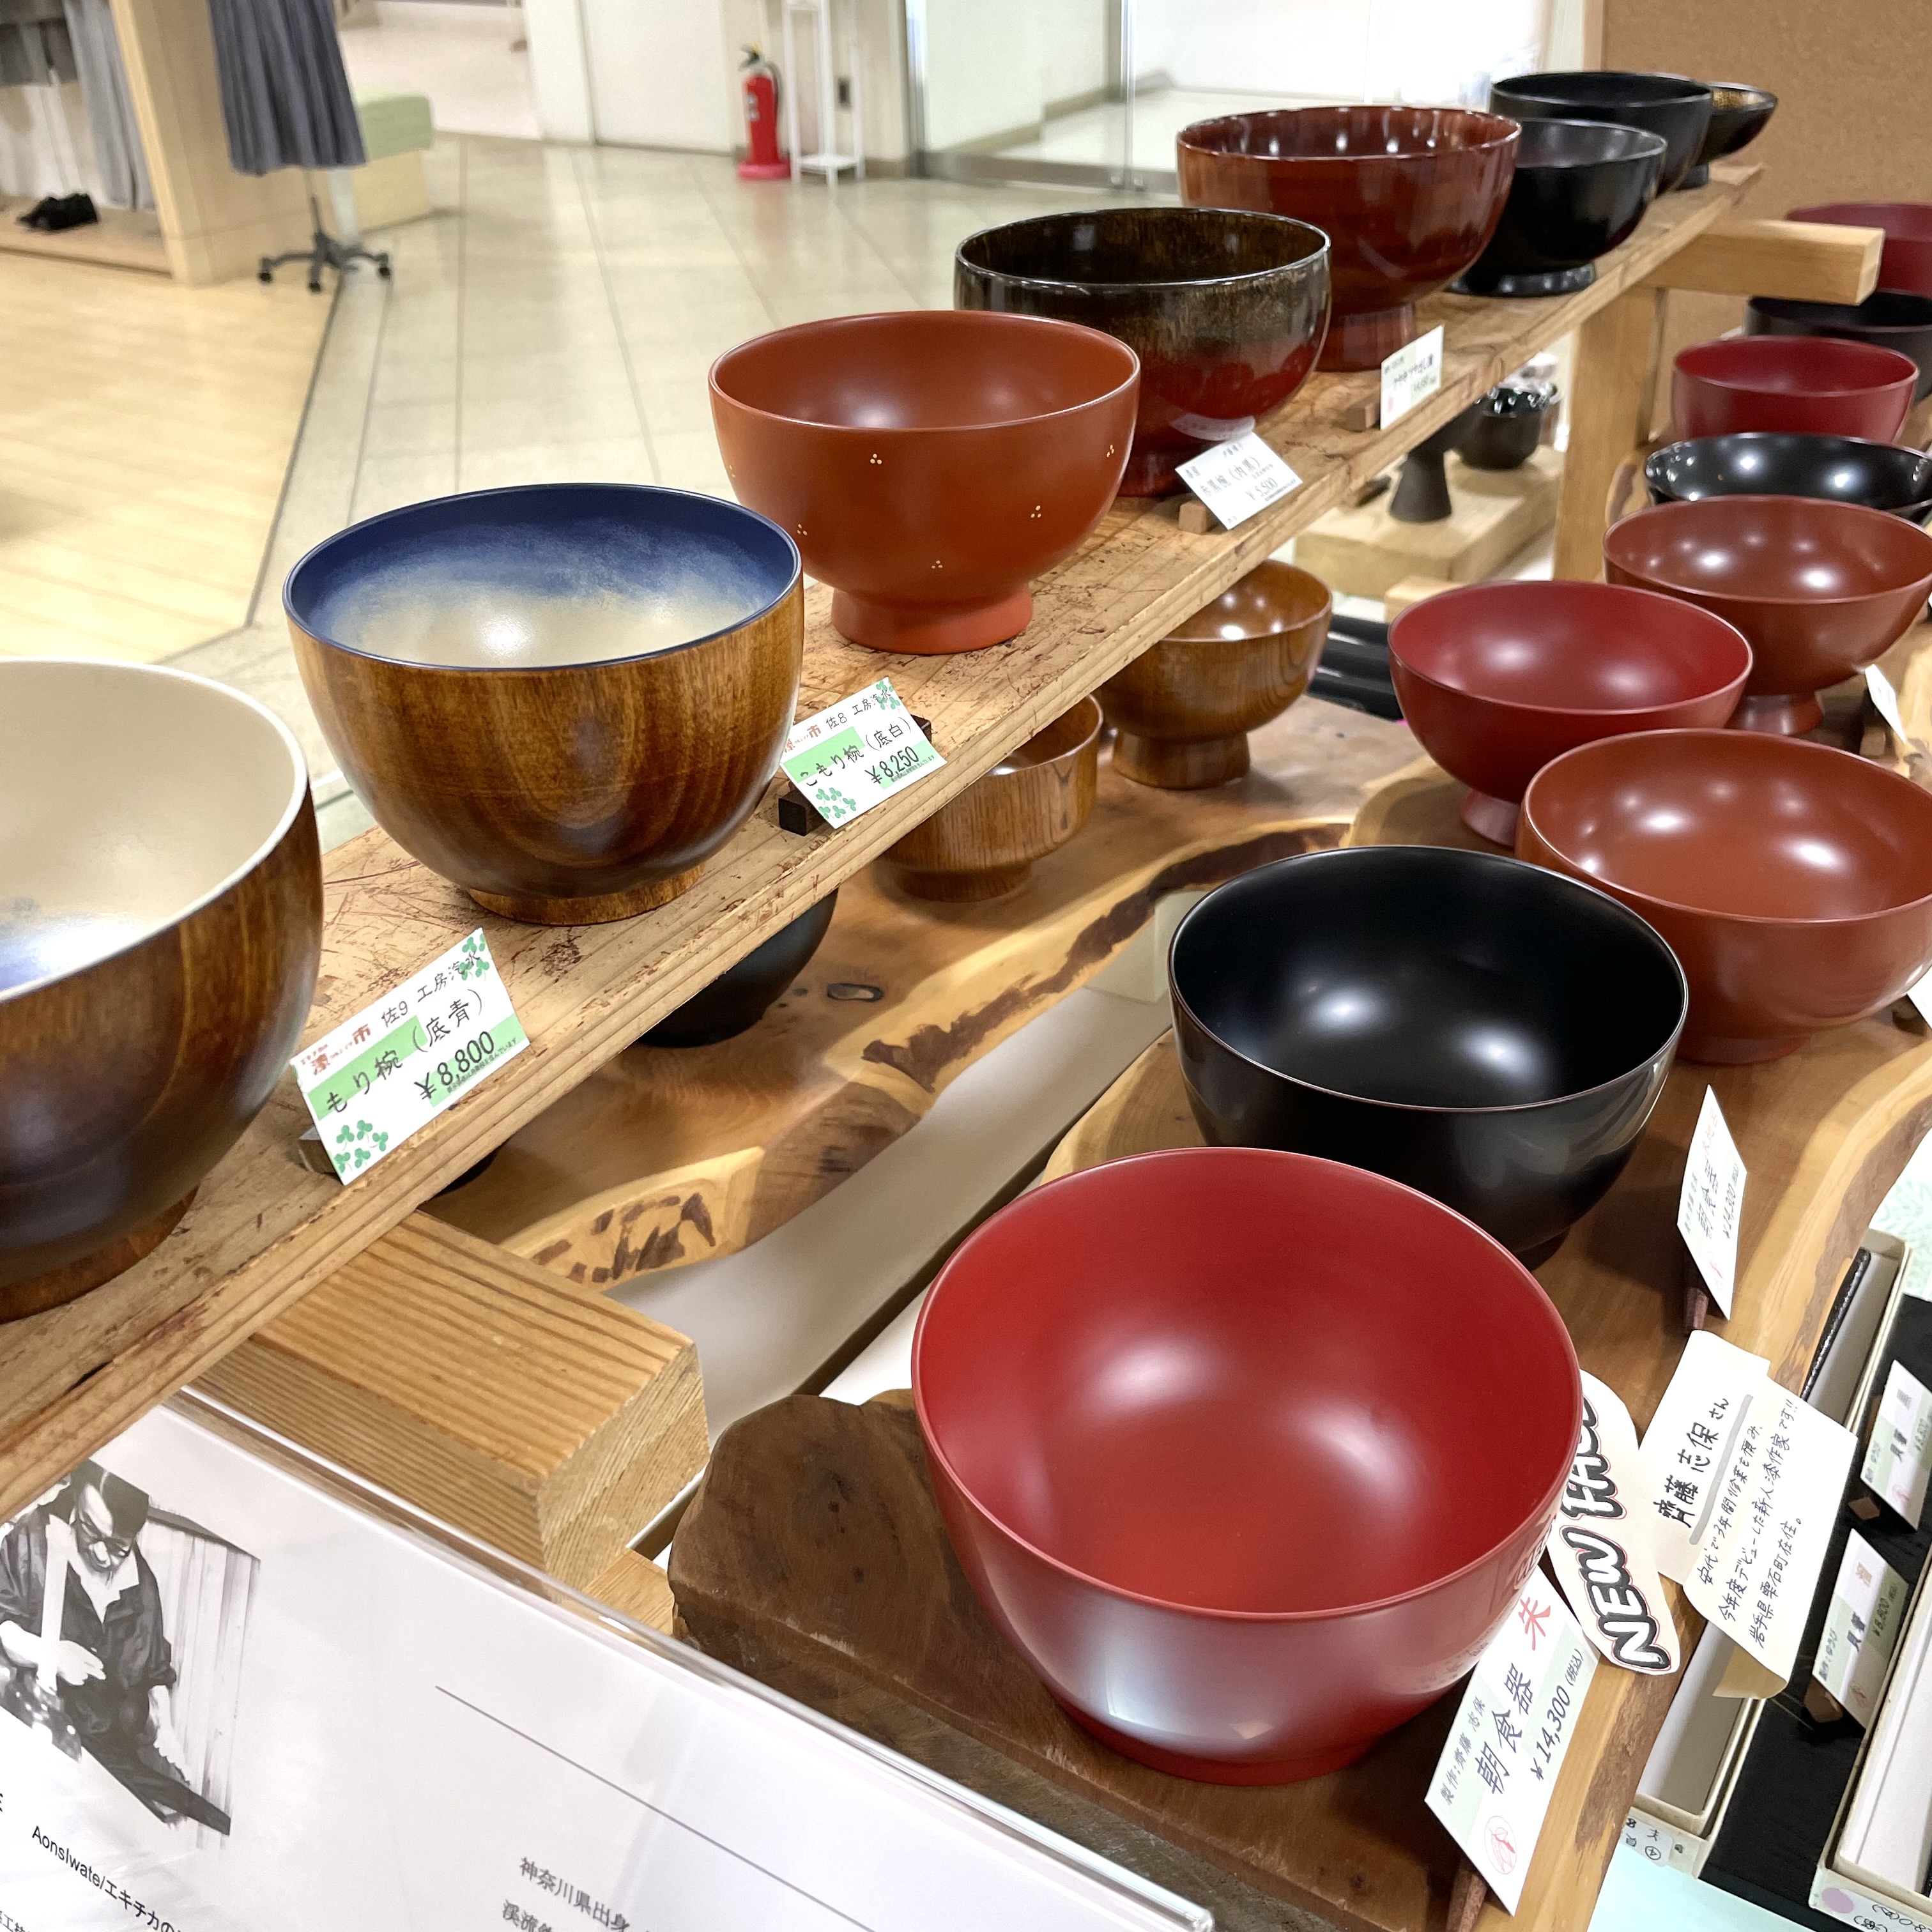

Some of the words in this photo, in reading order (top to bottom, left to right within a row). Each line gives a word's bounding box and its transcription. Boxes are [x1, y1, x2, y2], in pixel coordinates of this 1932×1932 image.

[864, 746, 919, 785] ¥8,250
[413, 1031, 494, 1101] ¥8,800
[1678, 1422, 1719, 1473] 志保
[1709, 1398, 1729, 1420] さん
[1518, 1597, 1551, 1651] 朱
[1563, 1526, 1671, 1669] NEW
[1475, 1663, 1533, 1794] 朝食器
[1530, 1685, 1570, 1780] ¥14,300
